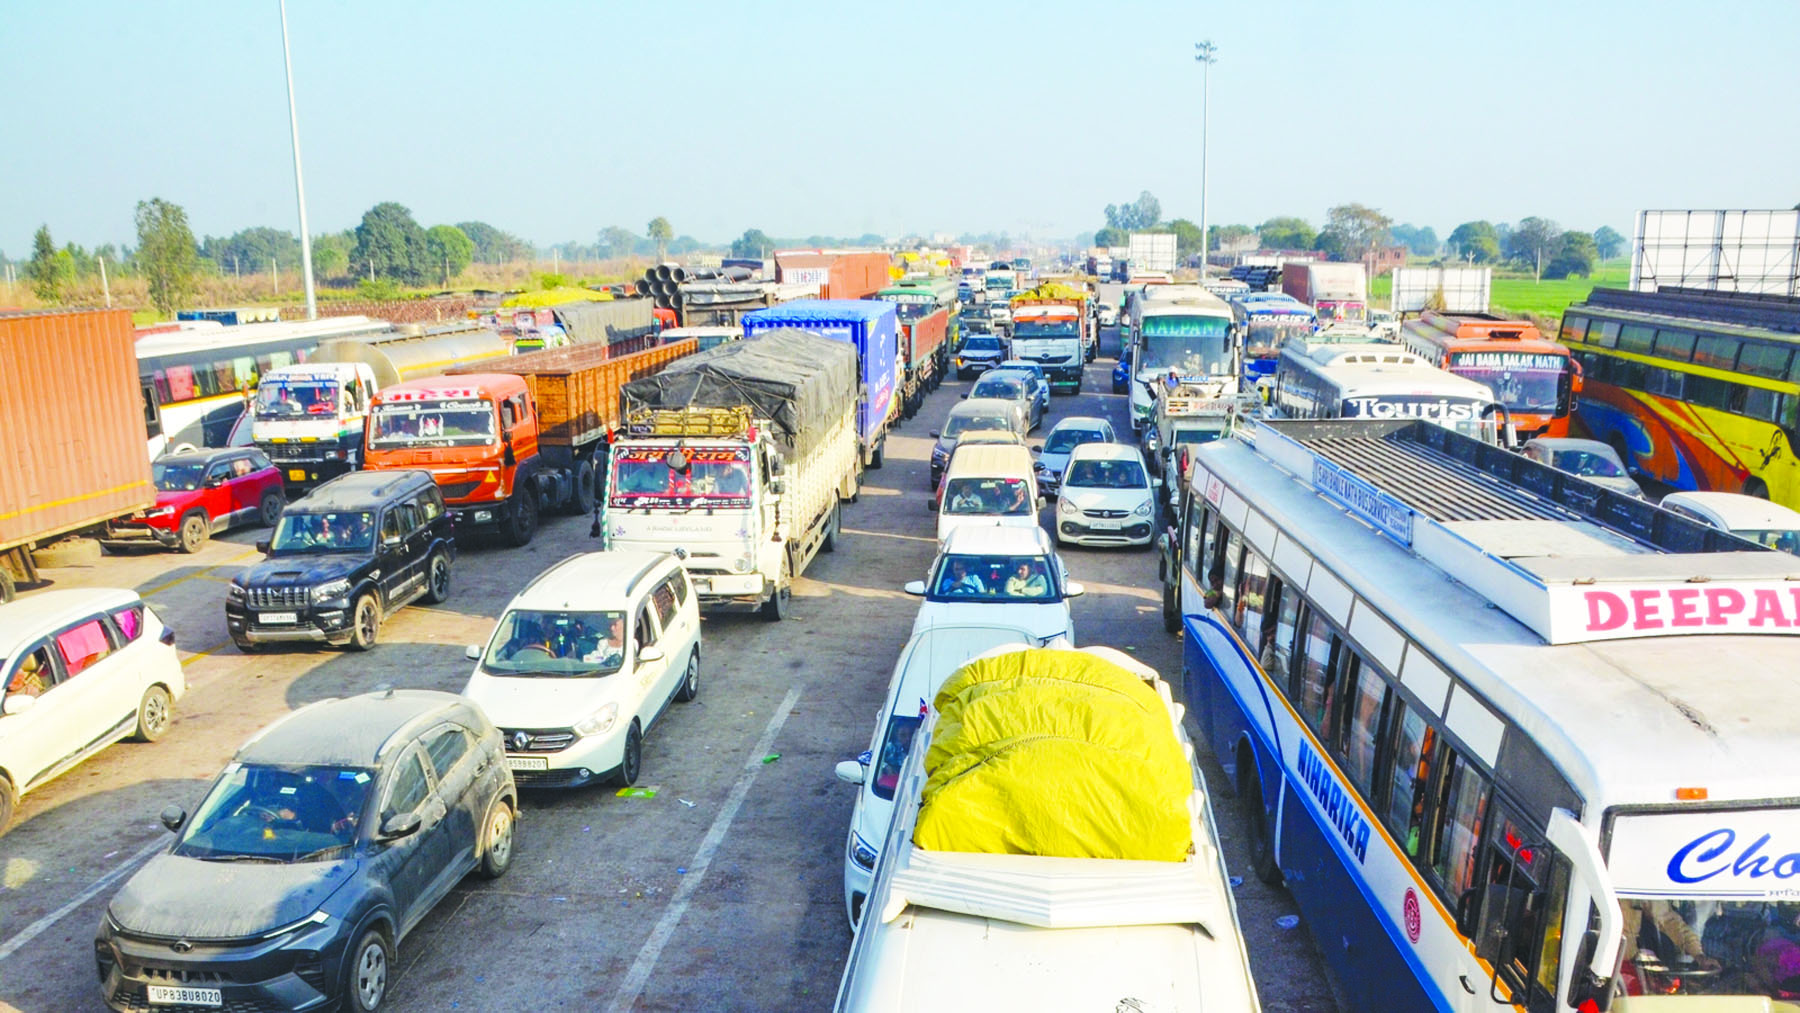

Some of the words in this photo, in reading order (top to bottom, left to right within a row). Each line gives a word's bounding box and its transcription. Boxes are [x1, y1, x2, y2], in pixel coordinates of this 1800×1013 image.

[1251, 315, 1311, 324] TOURIST
[1458, 353, 1474, 366] JAI
[1476, 354, 1502, 367] BABA
[1502, 354, 1534, 368] BALAK
[1535, 355, 1561, 369] NATH
[1348, 398, 1484, 420] Tourist
[1298, 737, 1371, 866] NIHARIKA
[156, 988, 221, 1003] UP83BU8020
